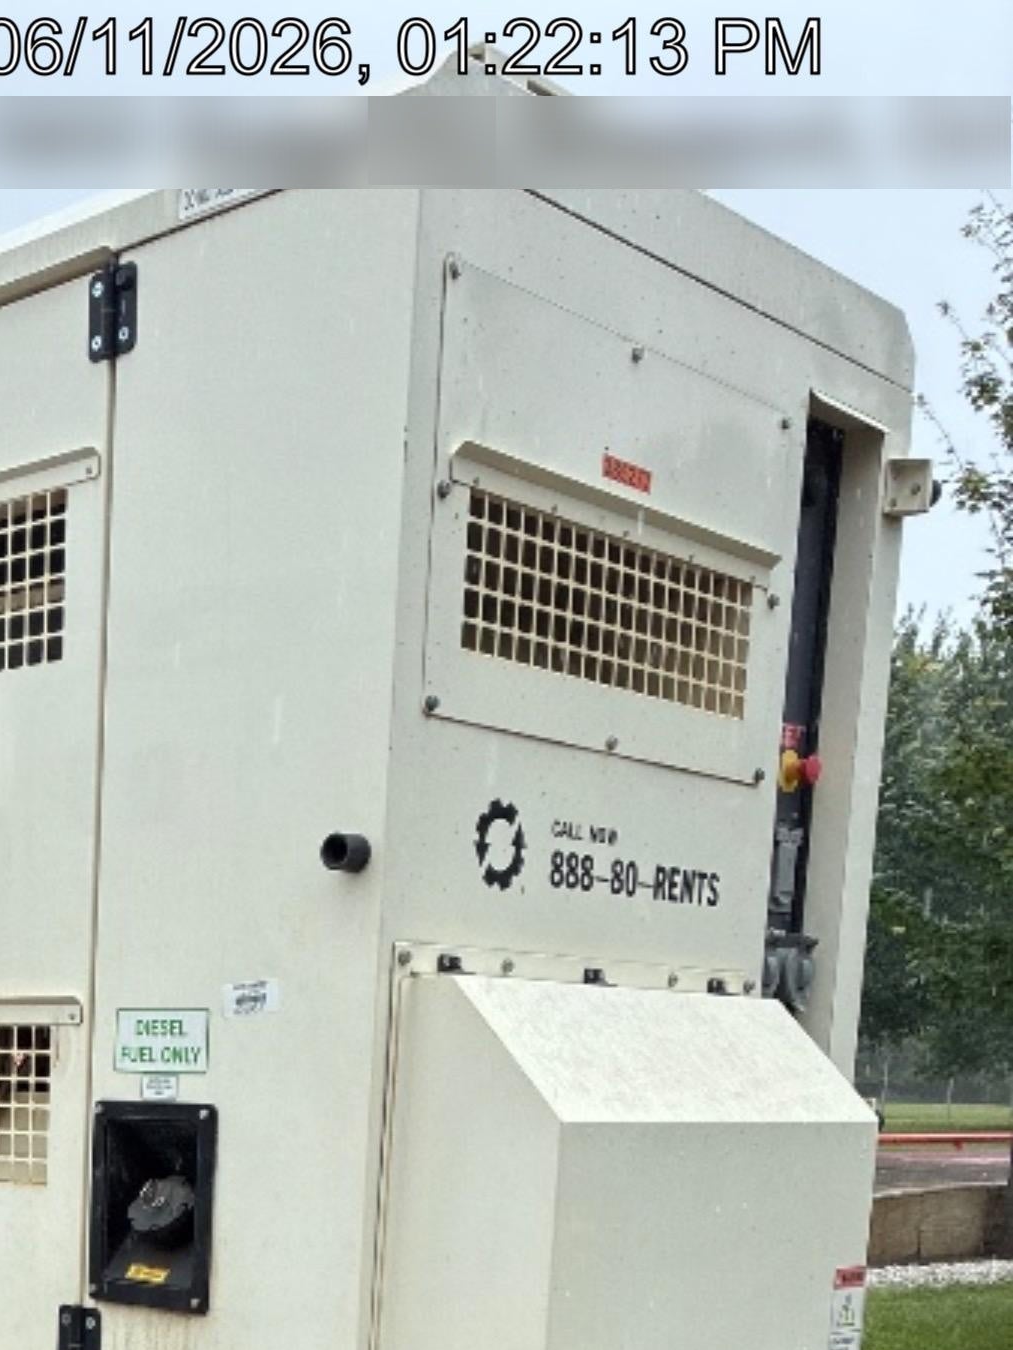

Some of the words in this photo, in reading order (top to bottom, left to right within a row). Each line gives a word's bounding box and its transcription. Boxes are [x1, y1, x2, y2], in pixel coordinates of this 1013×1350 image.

[551, 819, 583, 841] CALL
[589, 824, 619, 846] NOW
[550, 849, 721, 907] 888-80-RENTS
[136, 1018, 187, 1037] DIESEL
[121, 1045, 157, 1063] FUEL
[161, 1046, 201, 1065] ONLY
